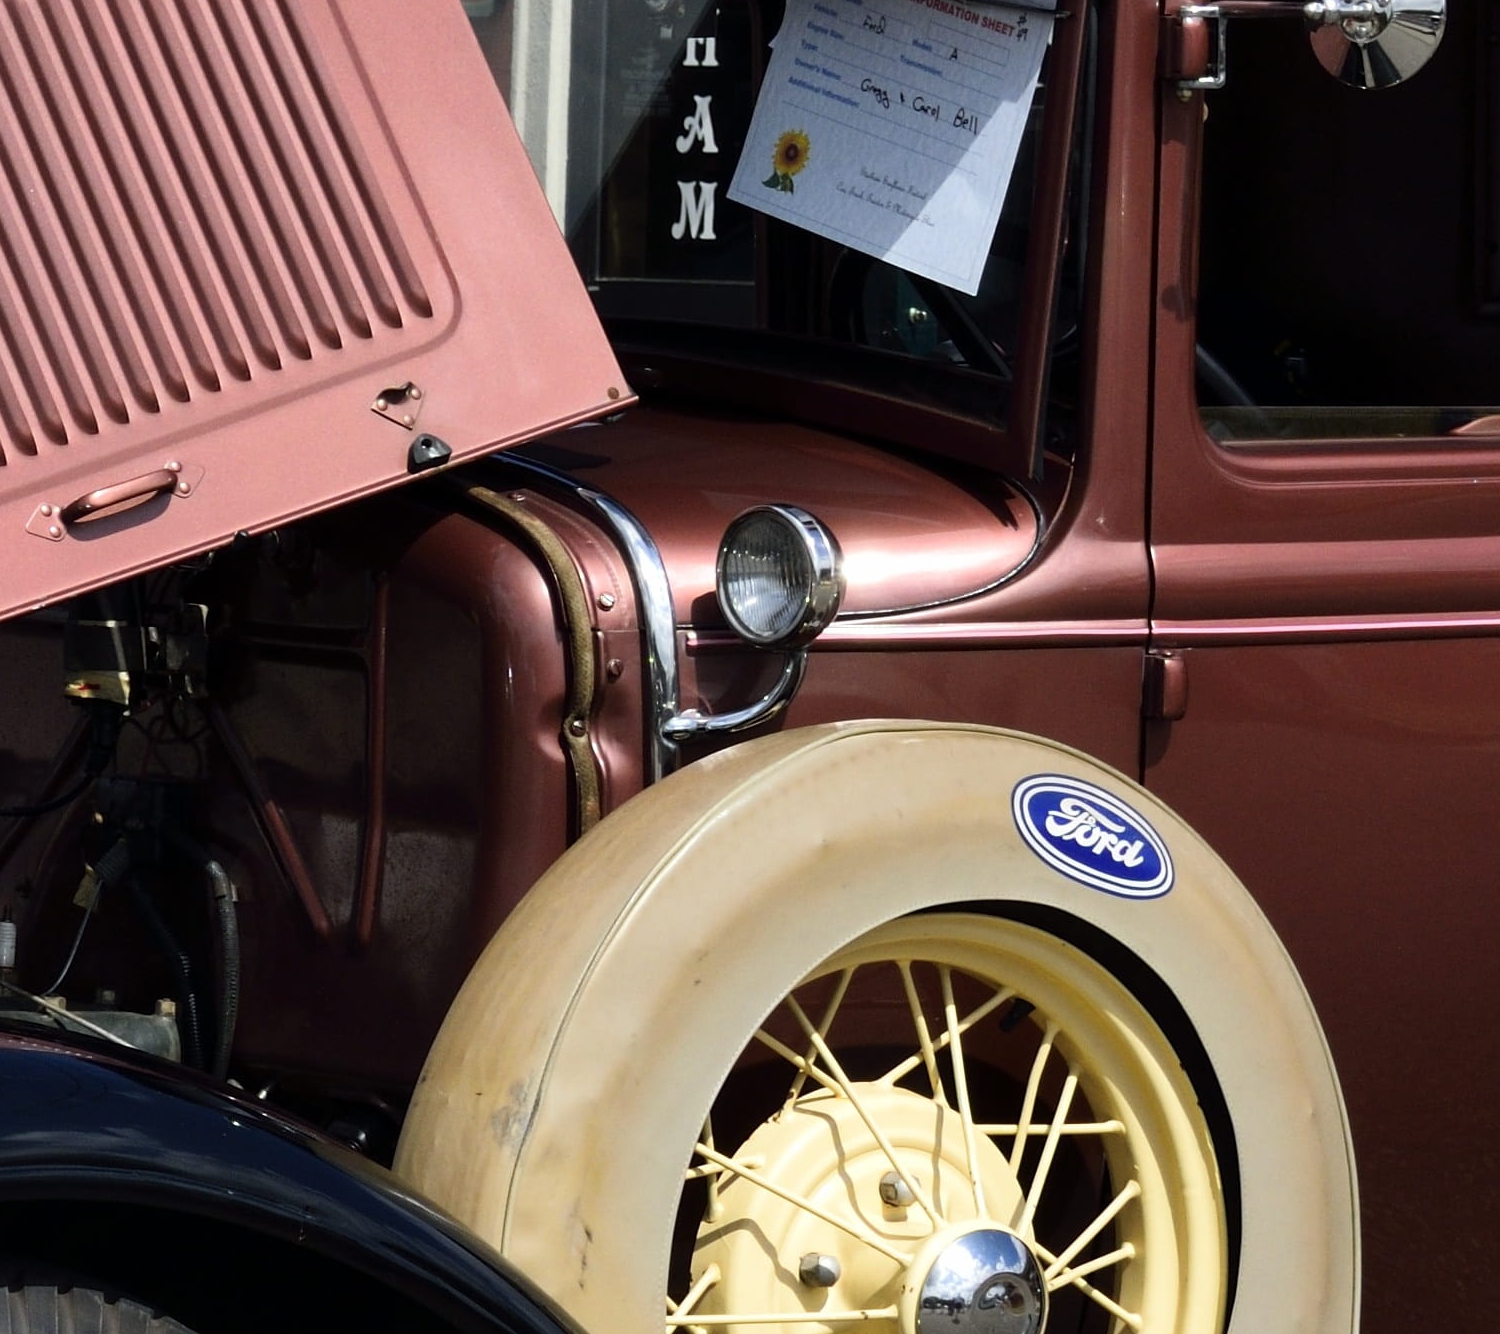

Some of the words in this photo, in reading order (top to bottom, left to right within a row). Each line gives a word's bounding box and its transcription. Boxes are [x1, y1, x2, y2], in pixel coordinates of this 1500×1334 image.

[980, 14, 1016, 37] SHEET
[912, 96, 941, 123] Carol
[952, 107, 979, 136] Bell
[1045, 797, 1145, 869] Ford
